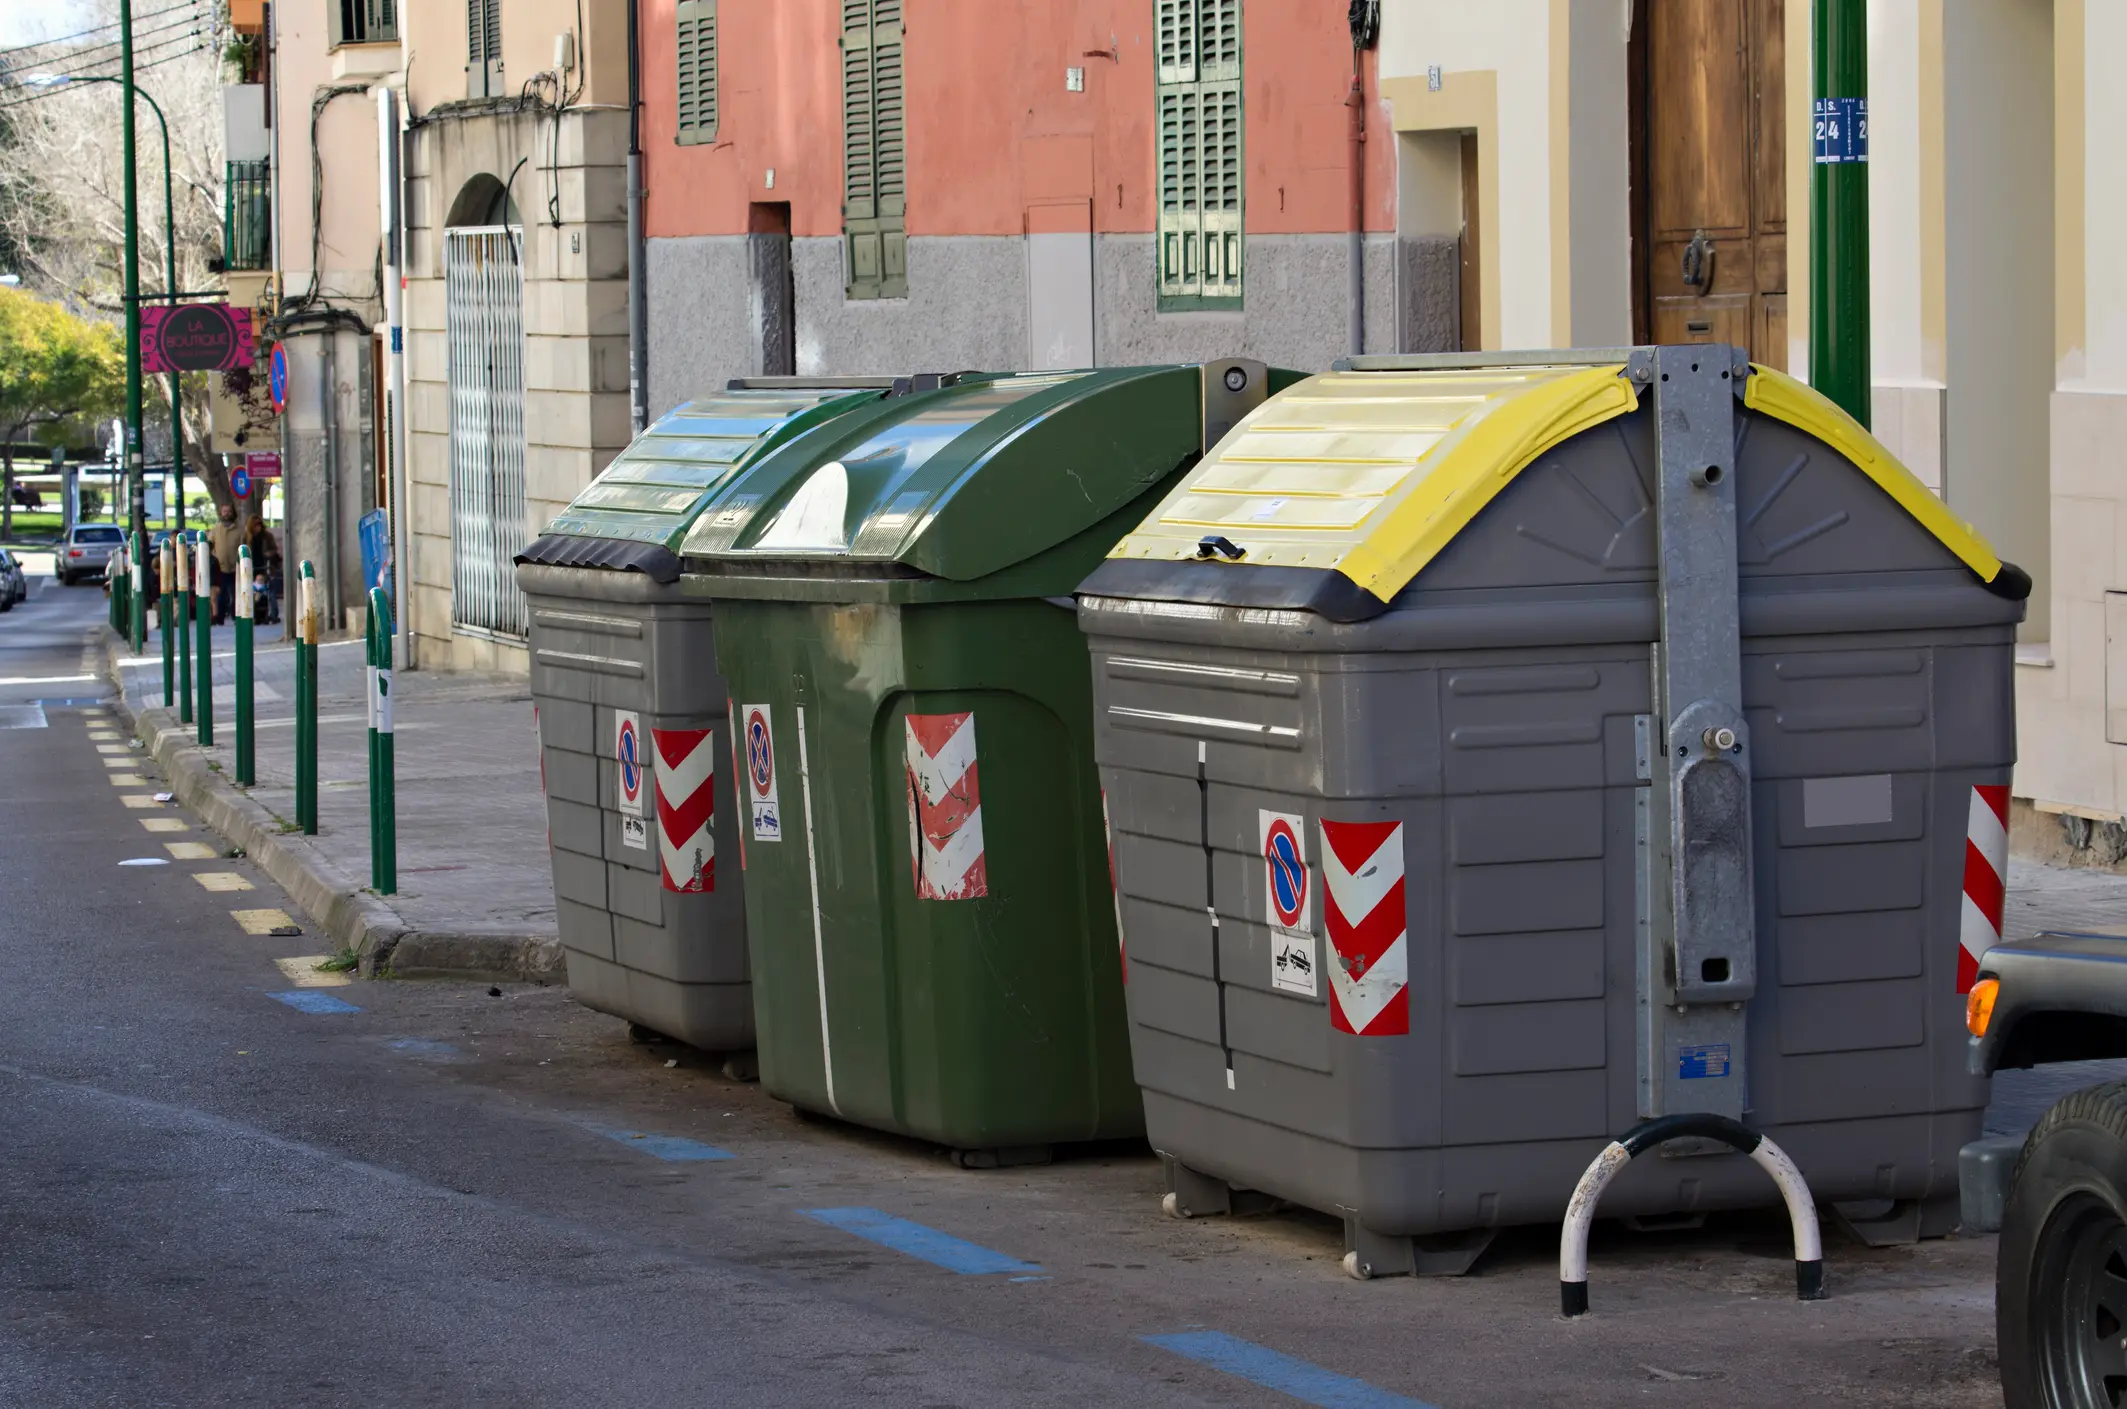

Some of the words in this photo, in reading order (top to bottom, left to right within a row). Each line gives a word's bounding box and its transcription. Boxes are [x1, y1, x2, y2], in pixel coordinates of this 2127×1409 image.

[1816, 101, 1824, 112] D.
[1827, 100, 1837, 111] S.
[187, 319, 205, 332] LA
[166, 332, 227, 348] BOUTIQUE
